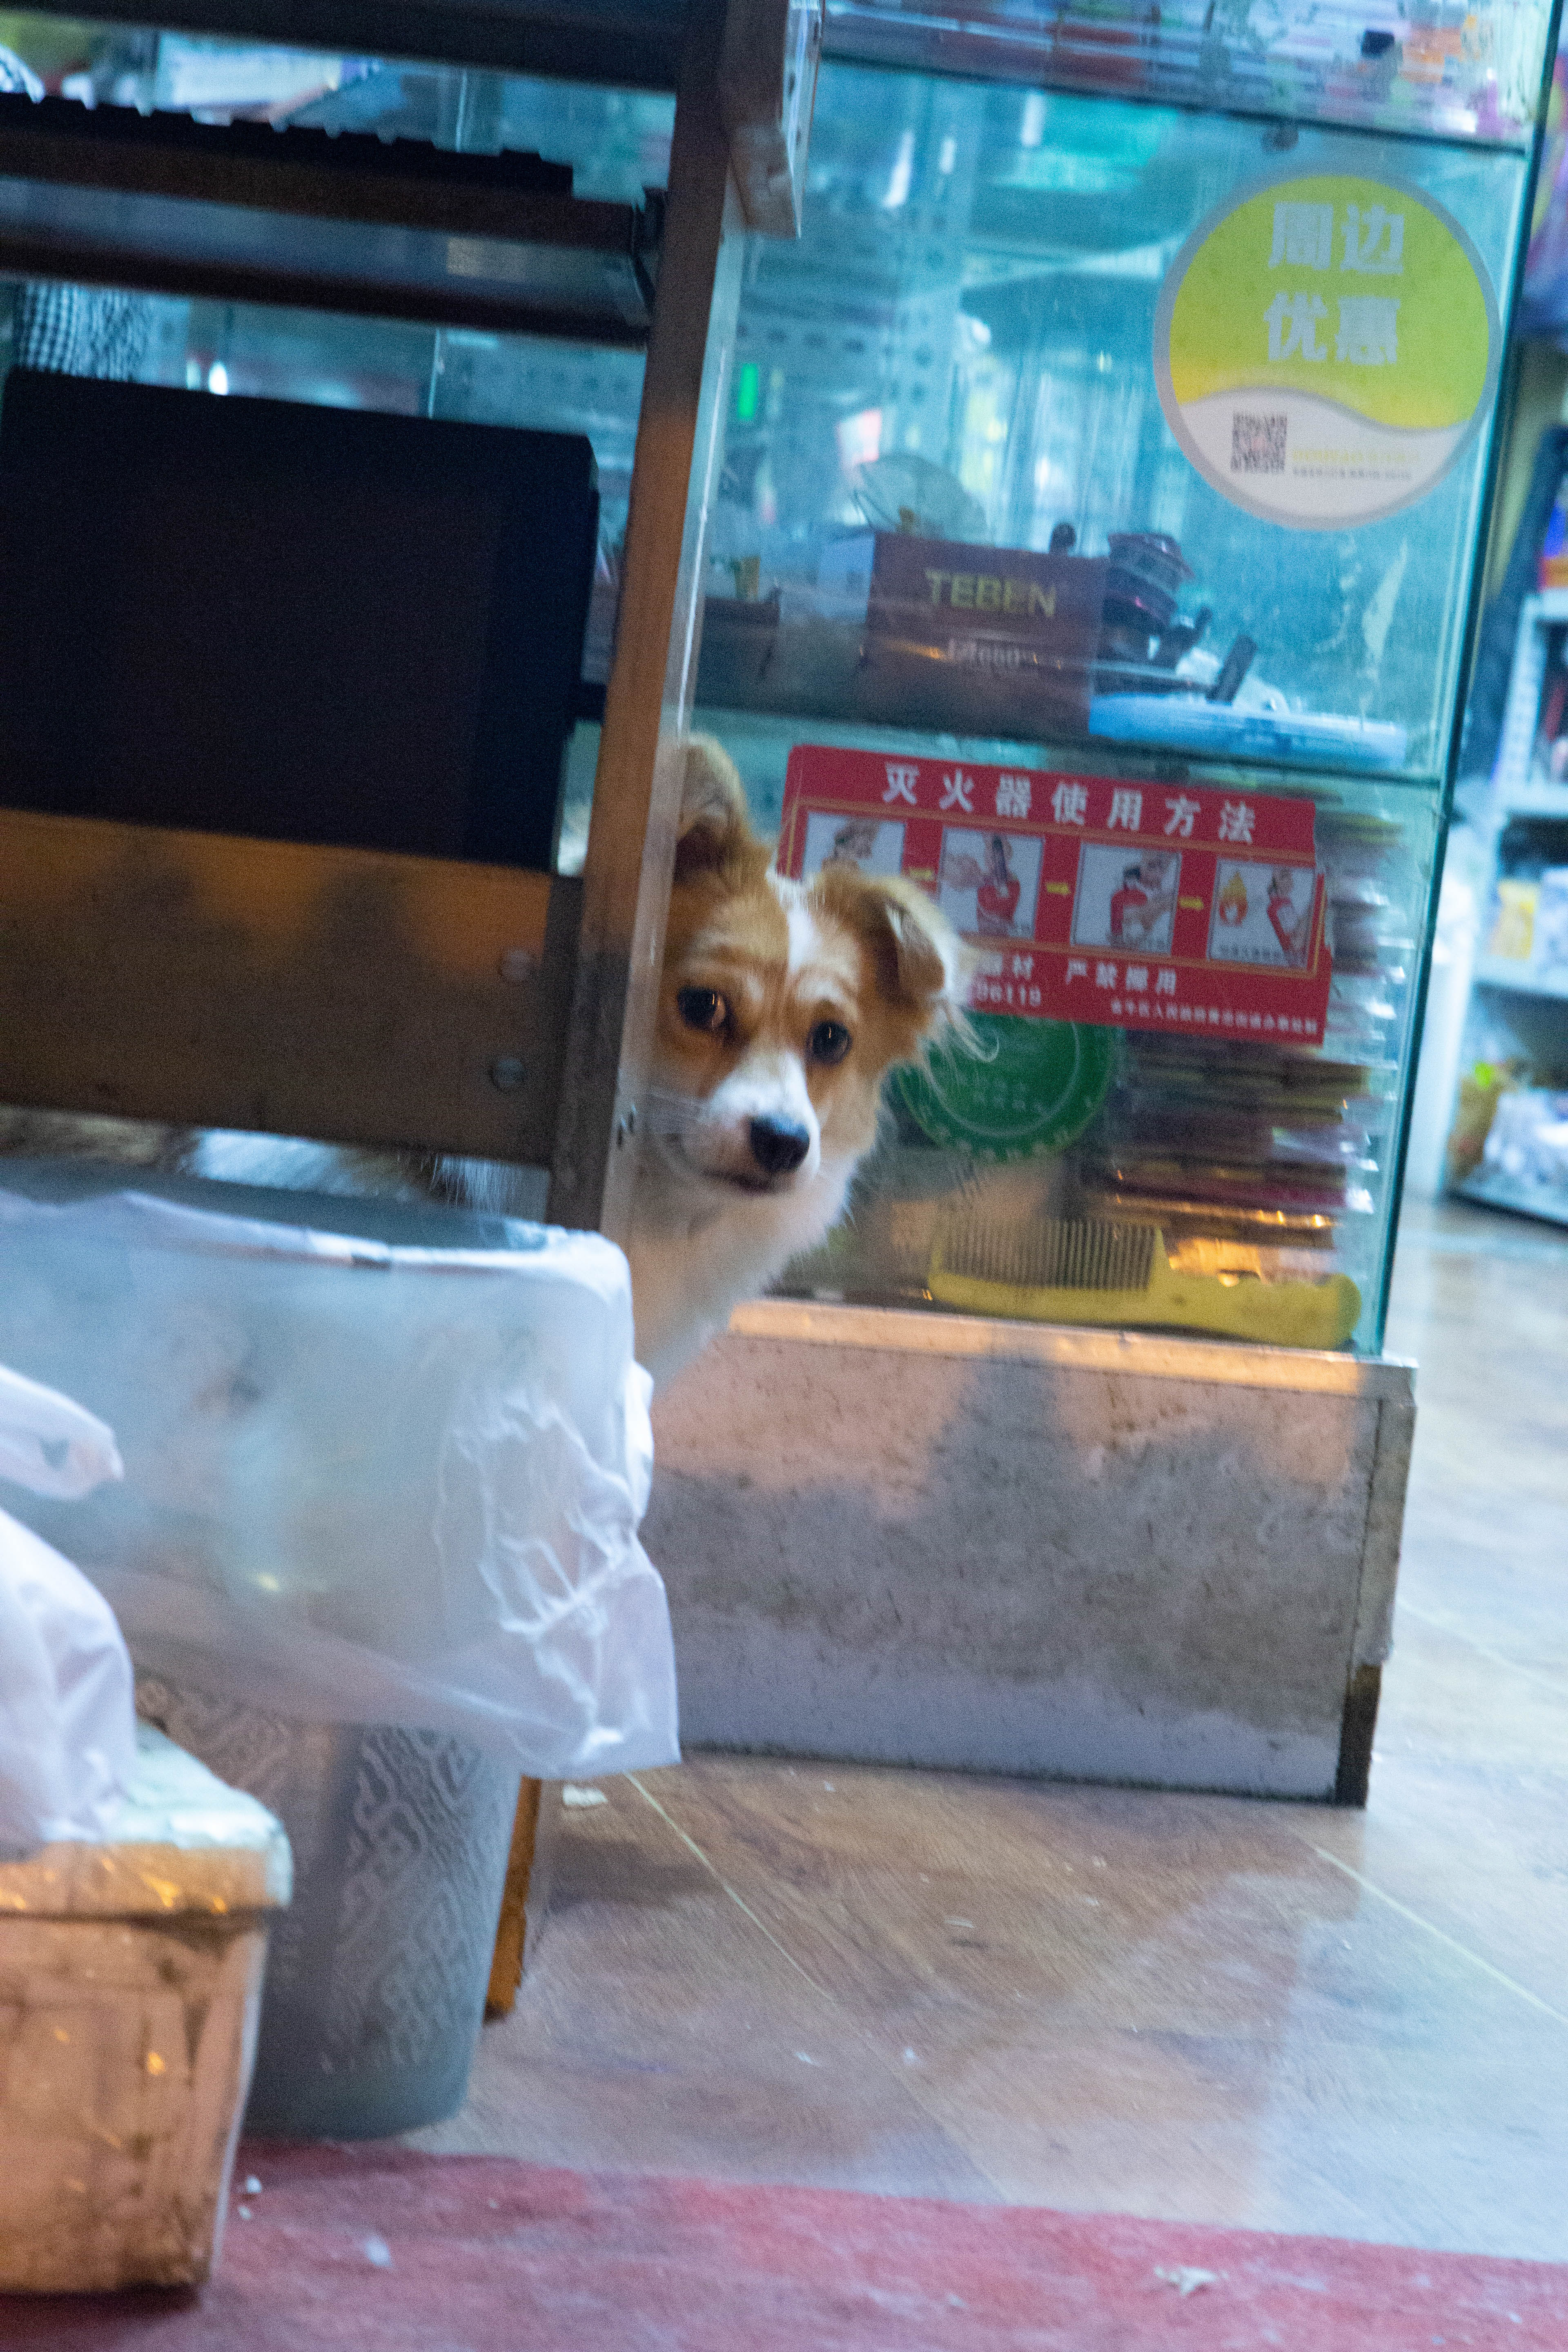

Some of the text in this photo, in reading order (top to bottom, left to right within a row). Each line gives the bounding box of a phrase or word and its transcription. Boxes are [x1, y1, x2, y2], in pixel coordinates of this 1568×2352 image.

[1269, 202, 1405, 275] 周边
[1263, 291, 1401, 366] 优惠
[882, 762, 1256, 844] 灭火器使用方法
